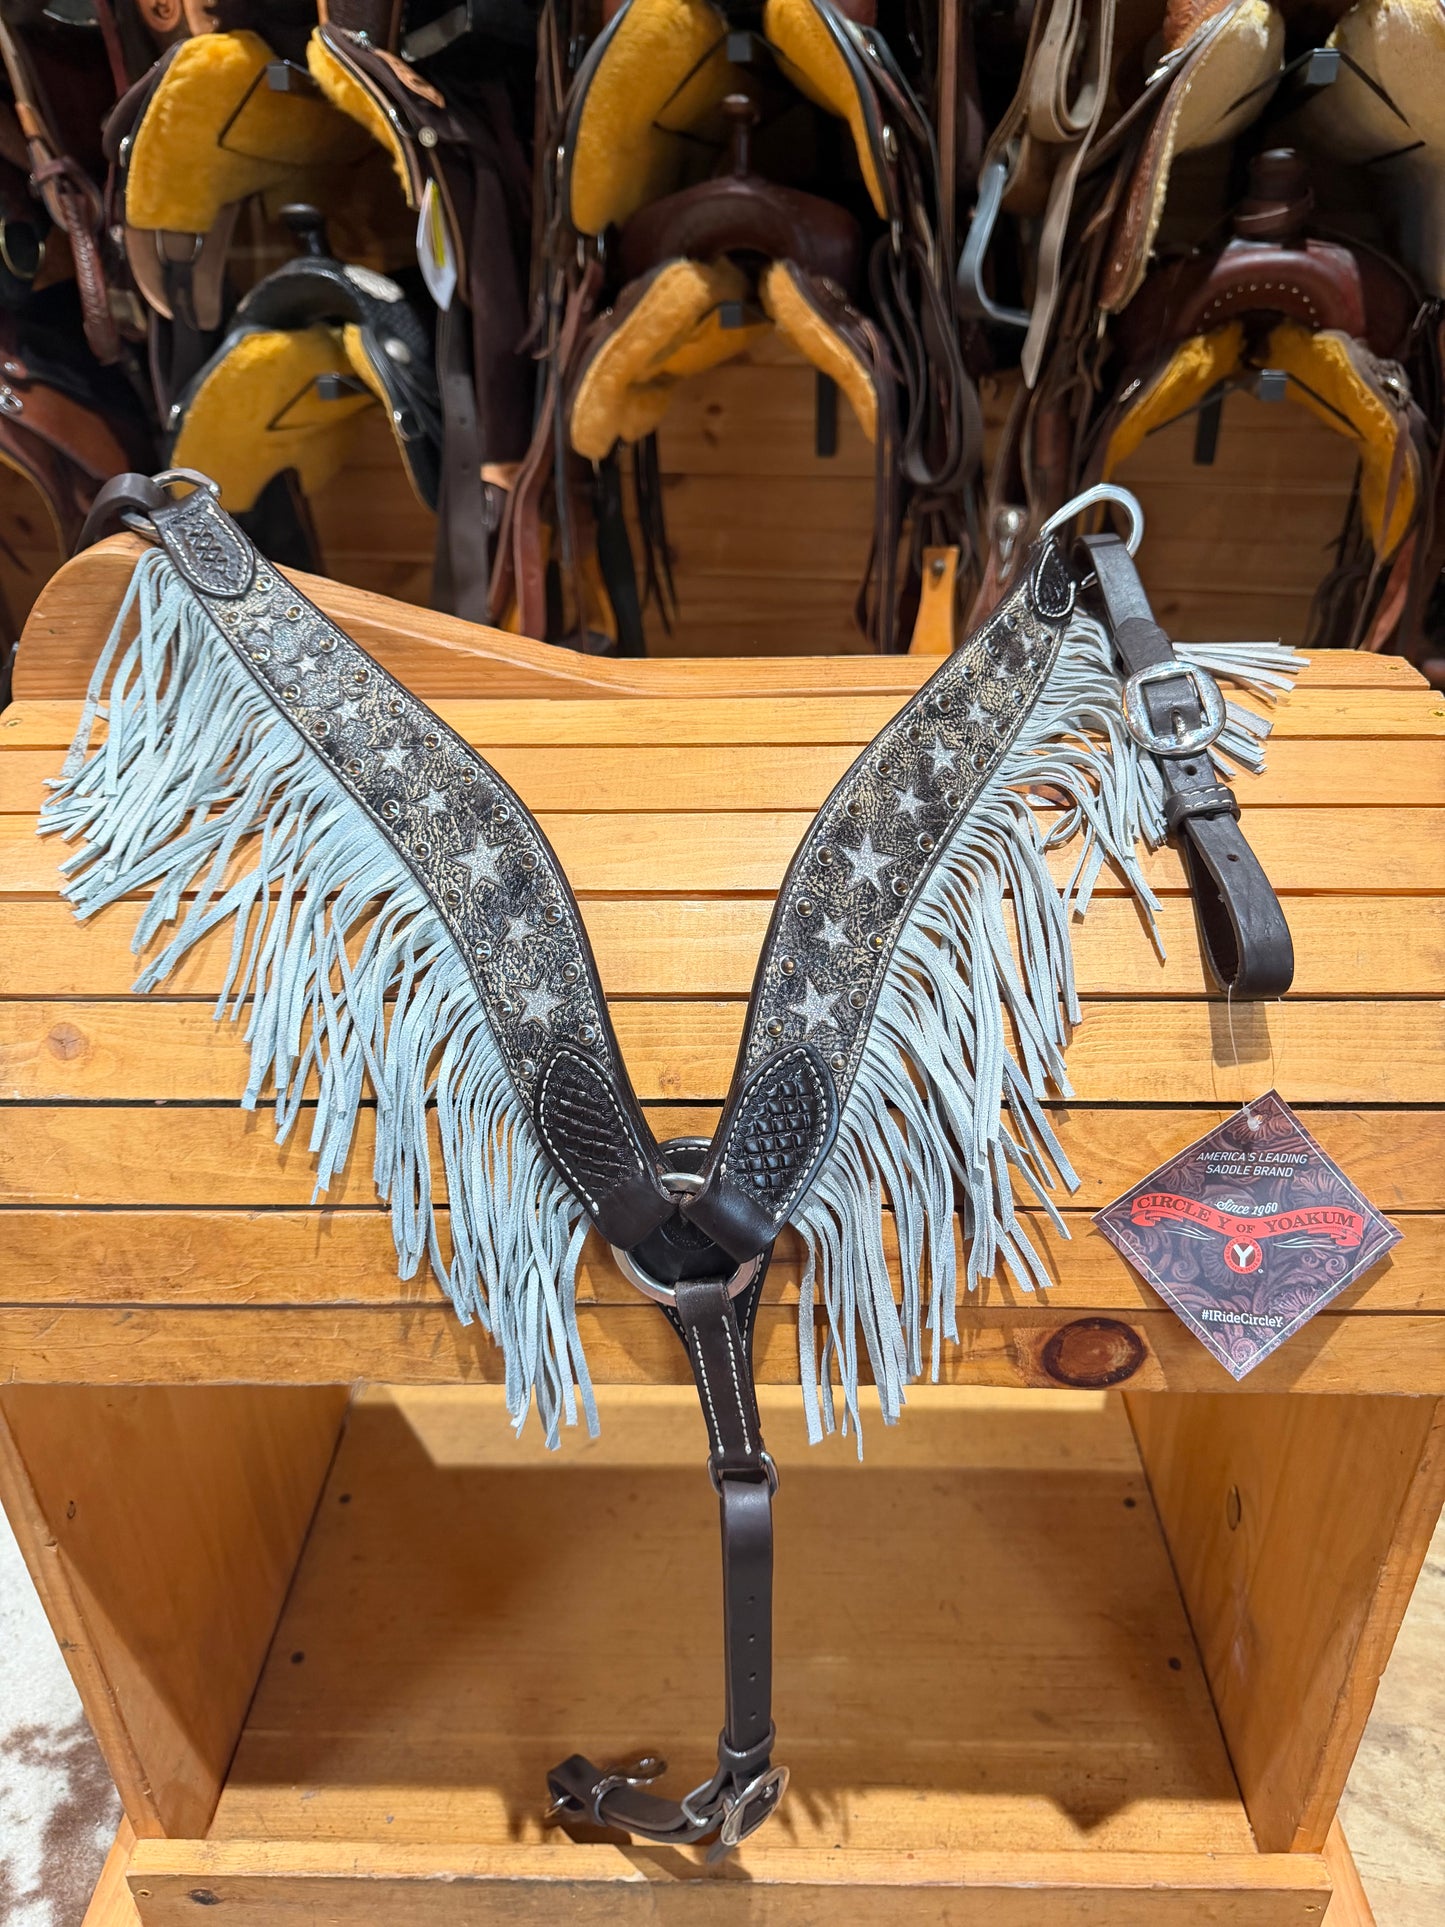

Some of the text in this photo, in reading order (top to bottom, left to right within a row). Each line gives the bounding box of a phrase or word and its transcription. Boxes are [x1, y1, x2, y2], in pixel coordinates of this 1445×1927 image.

[1196, 1151, 1309, 1165] AMERICA'S LEADING
[1205, 1164, 1294, 1178] SADDLE BRAND
[1136, 1196, 1355, 1234] CIRCLE Y OF YOAKUM
[1214, 1198, 1279, 1217] Since 1960
